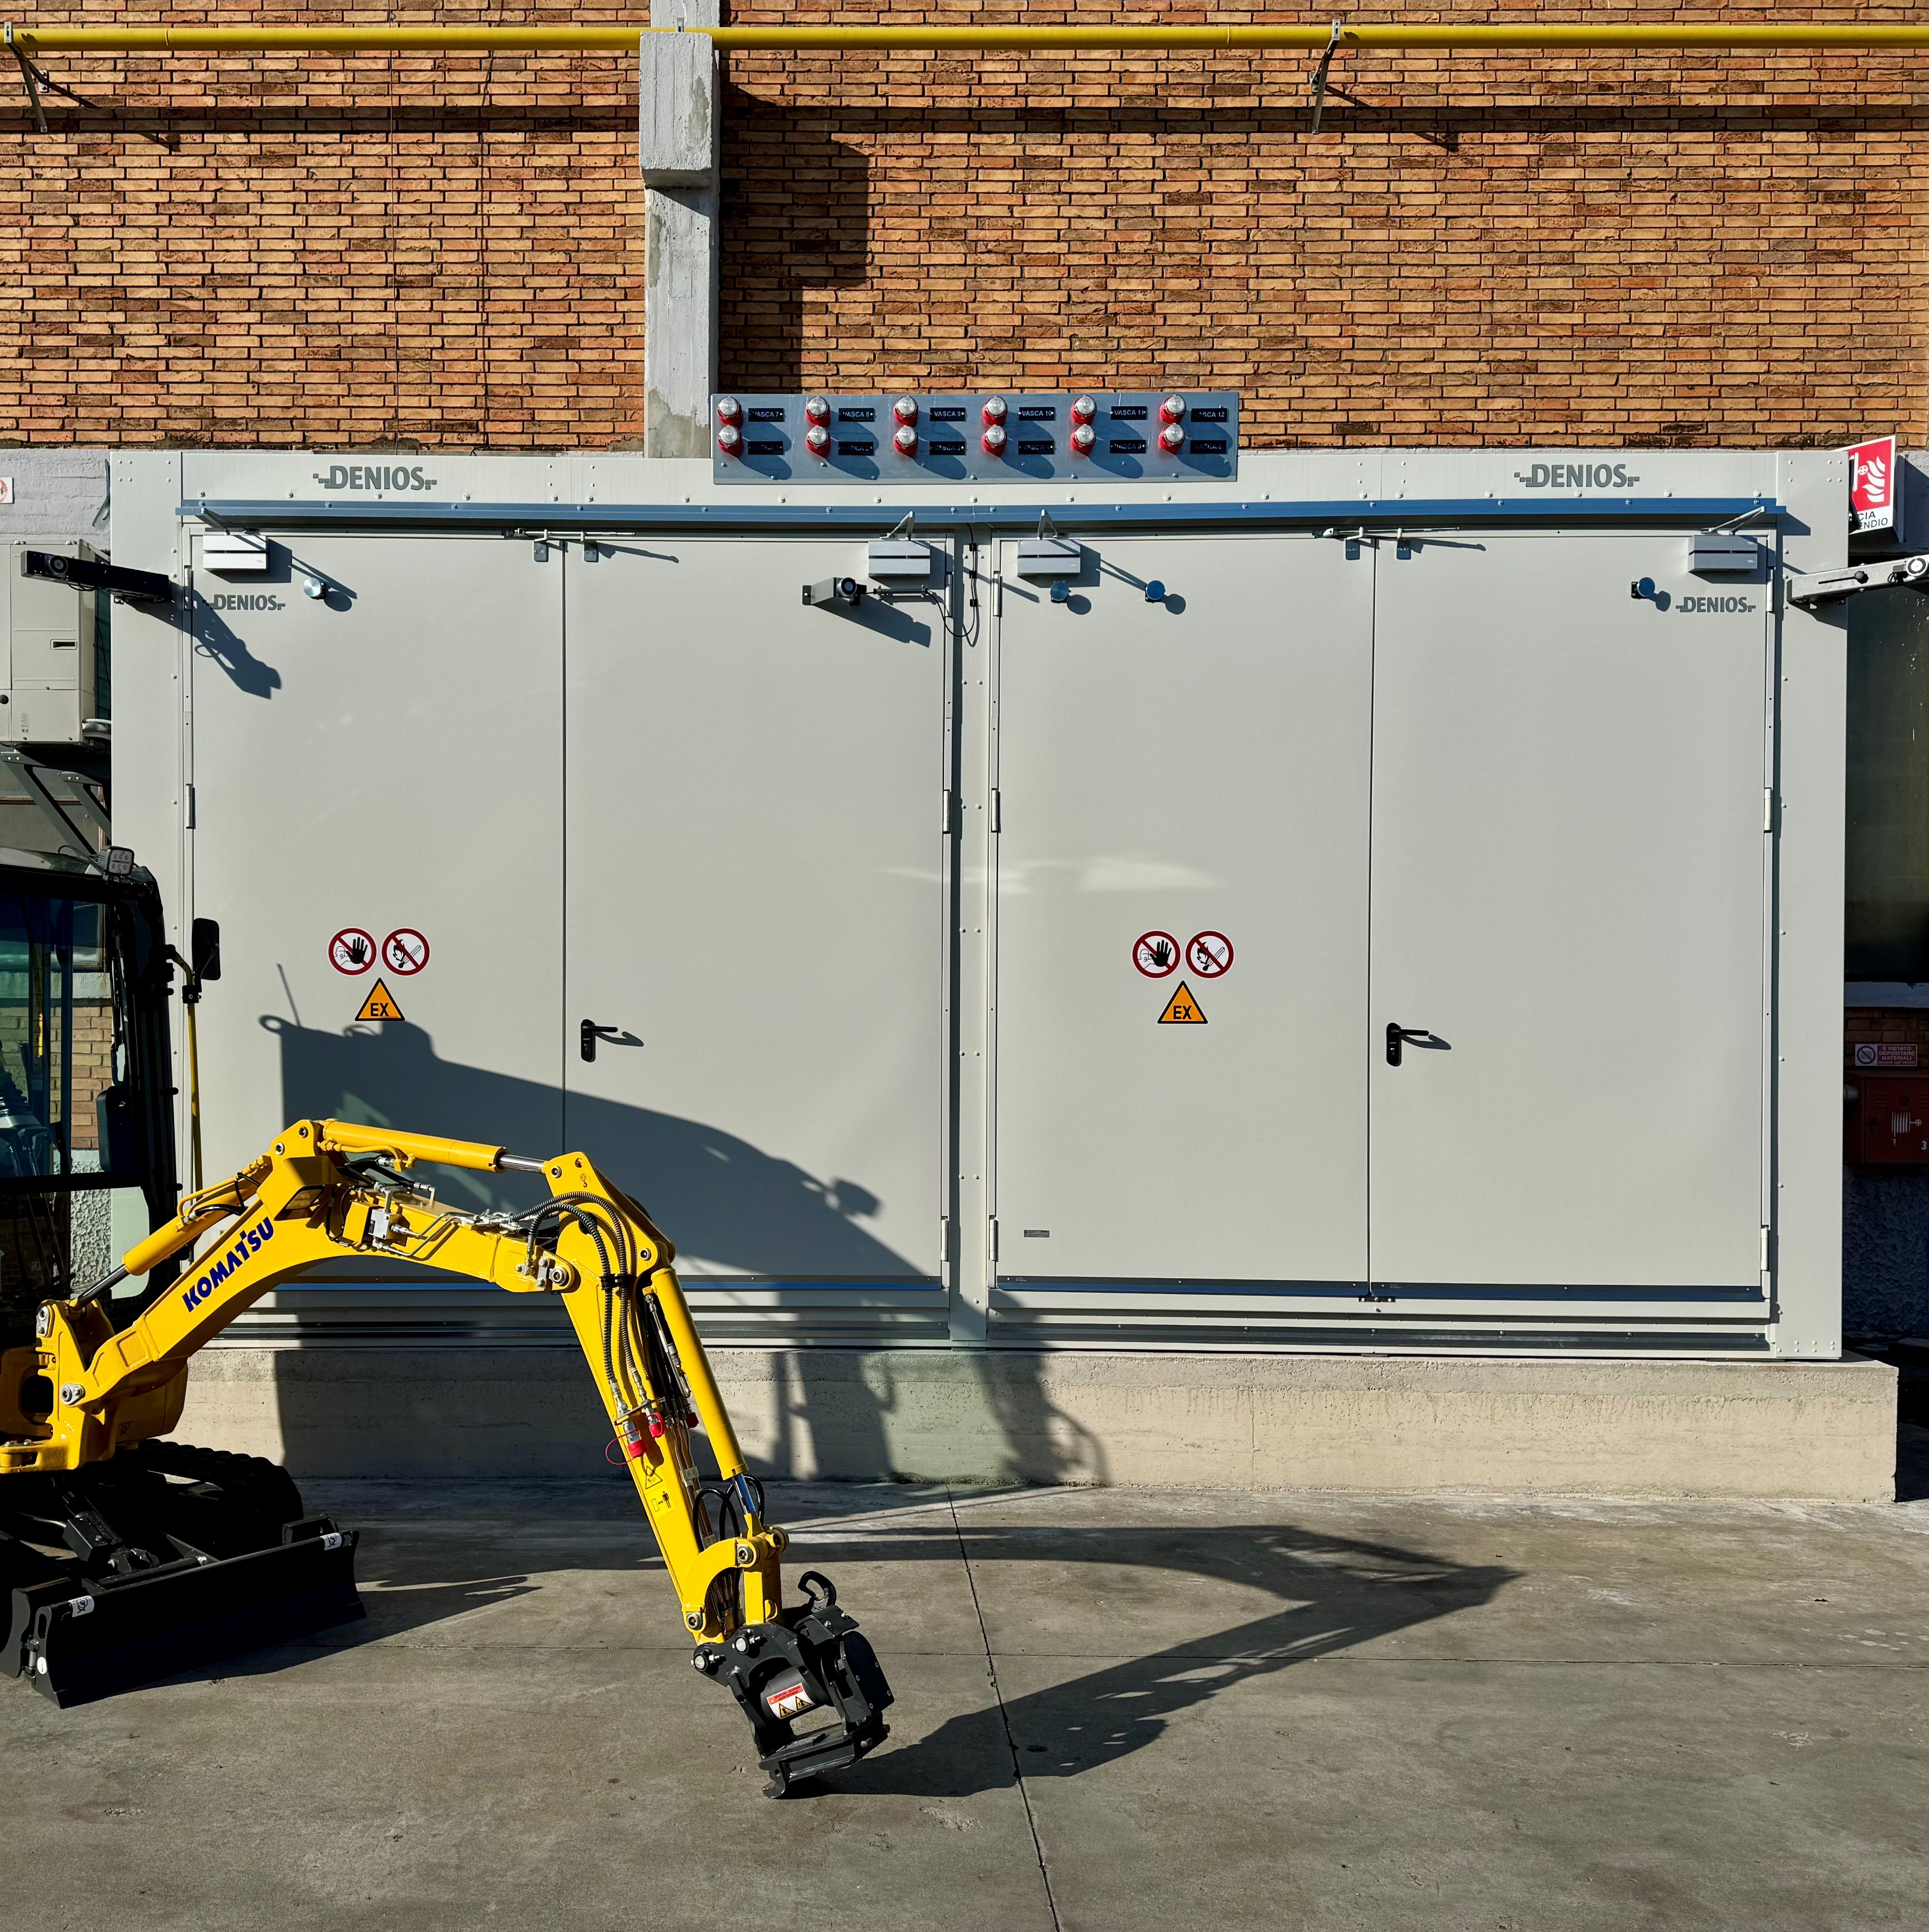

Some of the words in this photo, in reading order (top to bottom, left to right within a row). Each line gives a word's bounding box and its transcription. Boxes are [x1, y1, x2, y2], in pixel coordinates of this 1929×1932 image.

[324, 465, 424, 490] DENIOS
[1525, 464, 1627, 487] DENIOS
[210, 594, 276, 610] DENIOS
[1680, 597, 1748, 613] DENIOS
[370, 1003, 389, 1017] EX
[1173, 1005, 1192, 1020] EX
[1921, 1141, 1927, 1150] 3
[182, 1217, 274, 1312] KOMATSU
